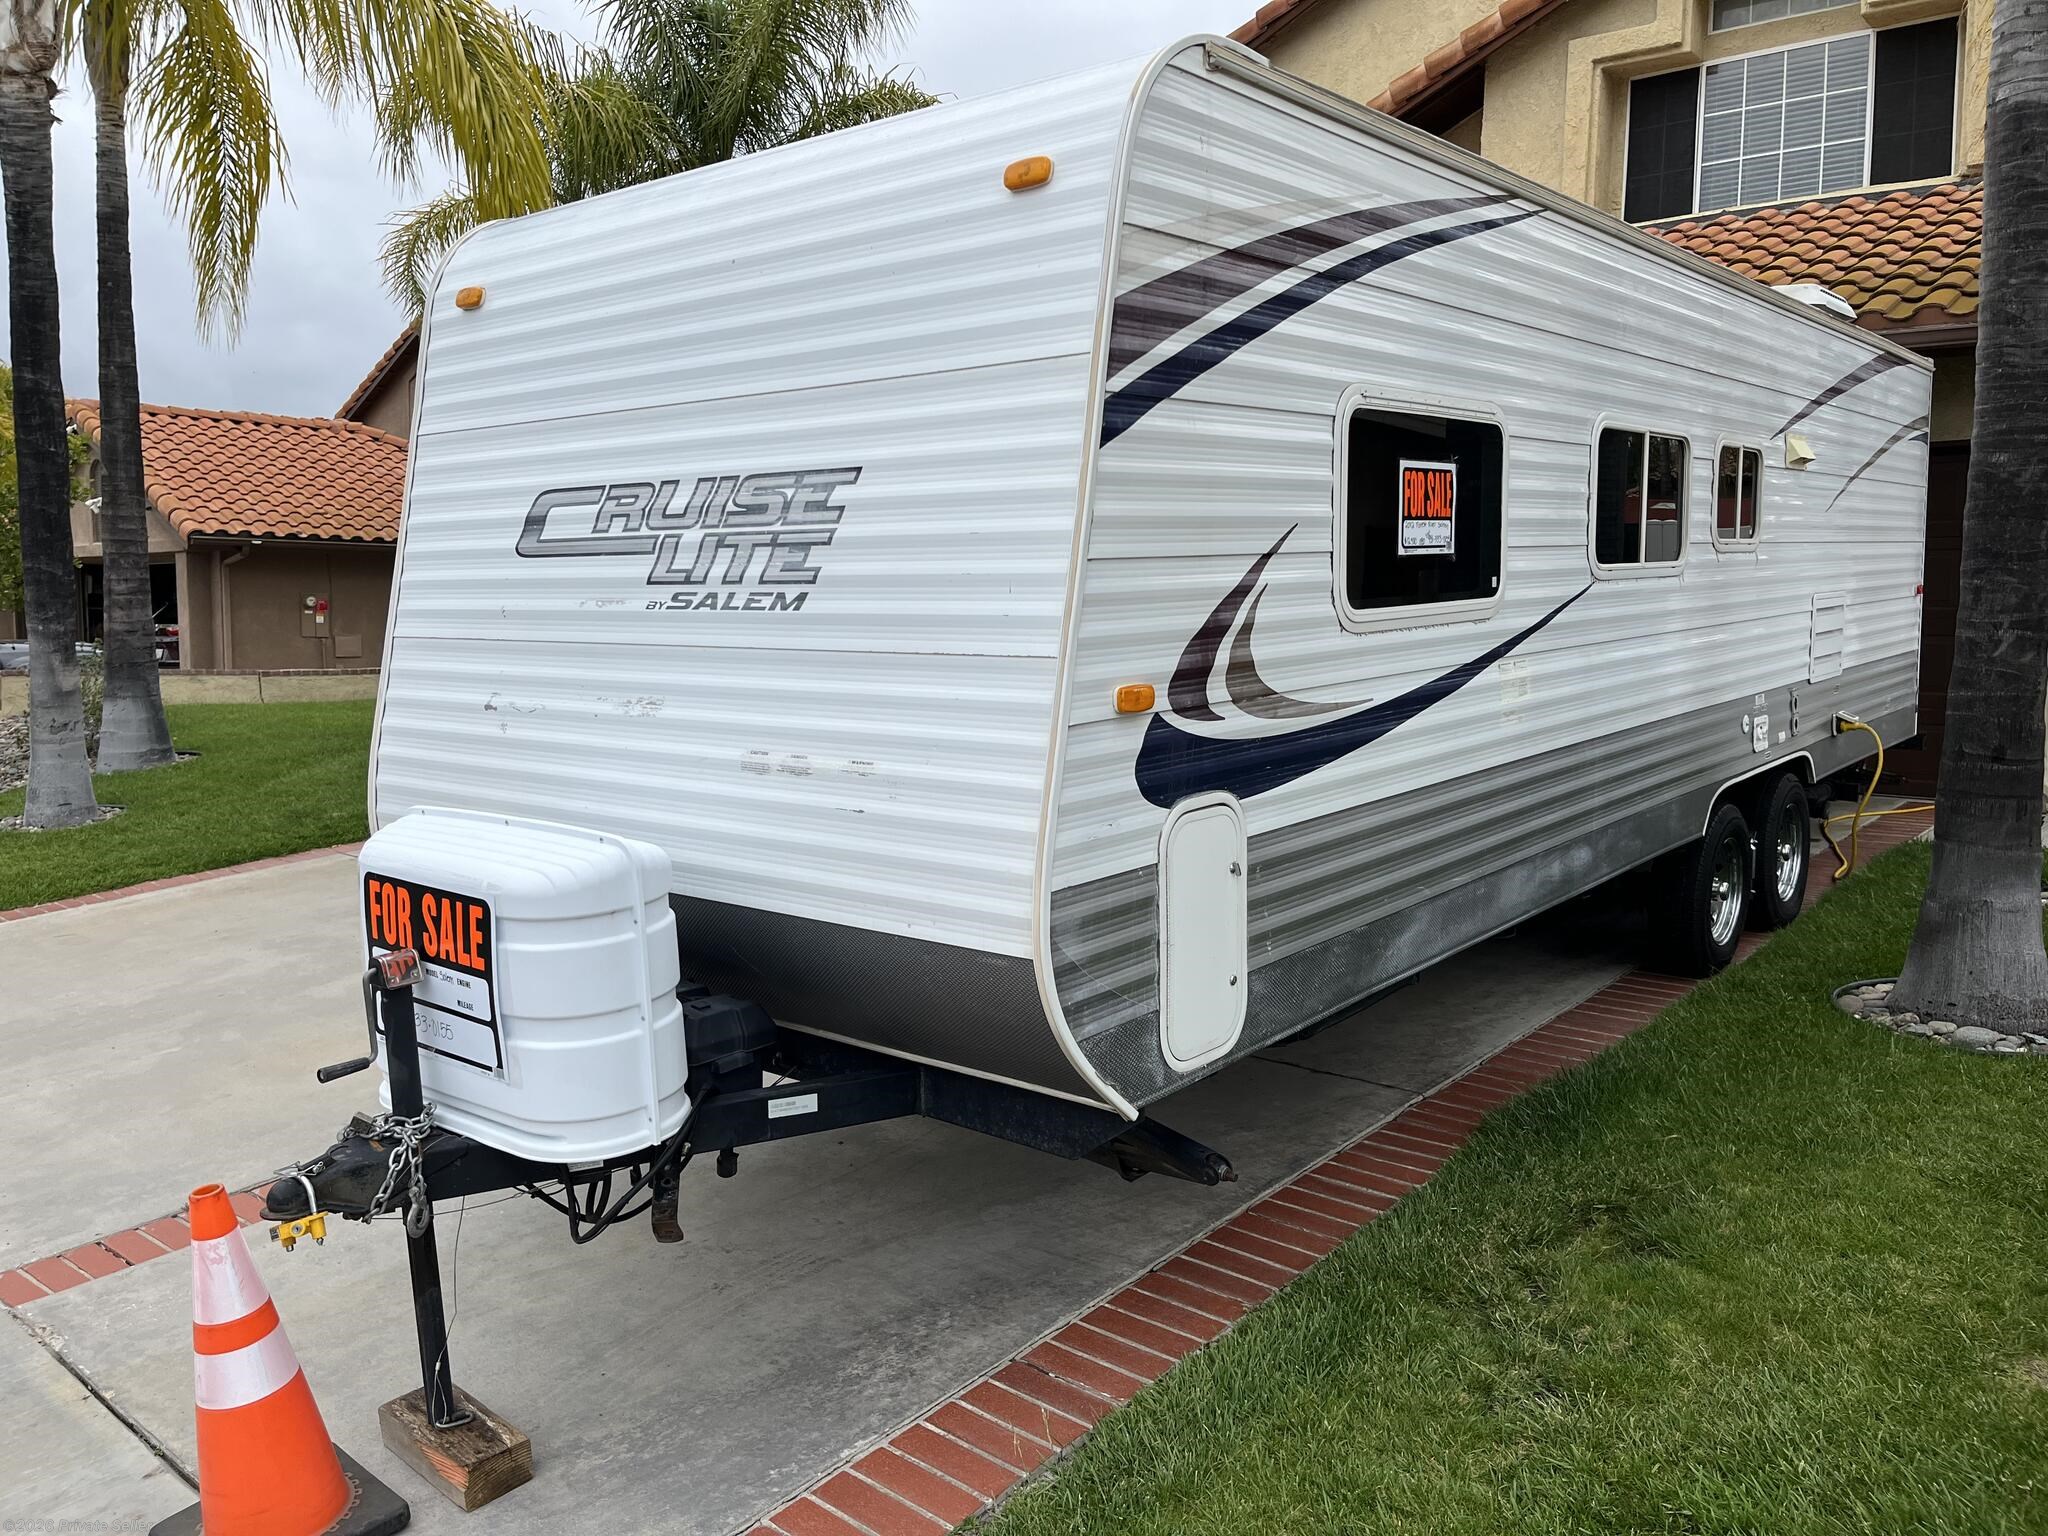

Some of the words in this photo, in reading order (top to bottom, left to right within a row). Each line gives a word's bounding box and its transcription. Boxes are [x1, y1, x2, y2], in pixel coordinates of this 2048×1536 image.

[1404, 470, 1425, 517] FOR
[1427, 471, 1452, 518] SALE
[515, 466, 863, 558] CRUISE
[646, 527, 838, 586] LITE
[646, 600, 668, 610] BY
[665, 592, 809, 612] SALEM
[369, 879, 413, 949] FOR
[422, 893, 486, 971] SALE
[425, 967, 439, 979] MODEL
[456, 977, 472, 990] ENGINE
[456, 999, 475, 1012] MILEAGE
